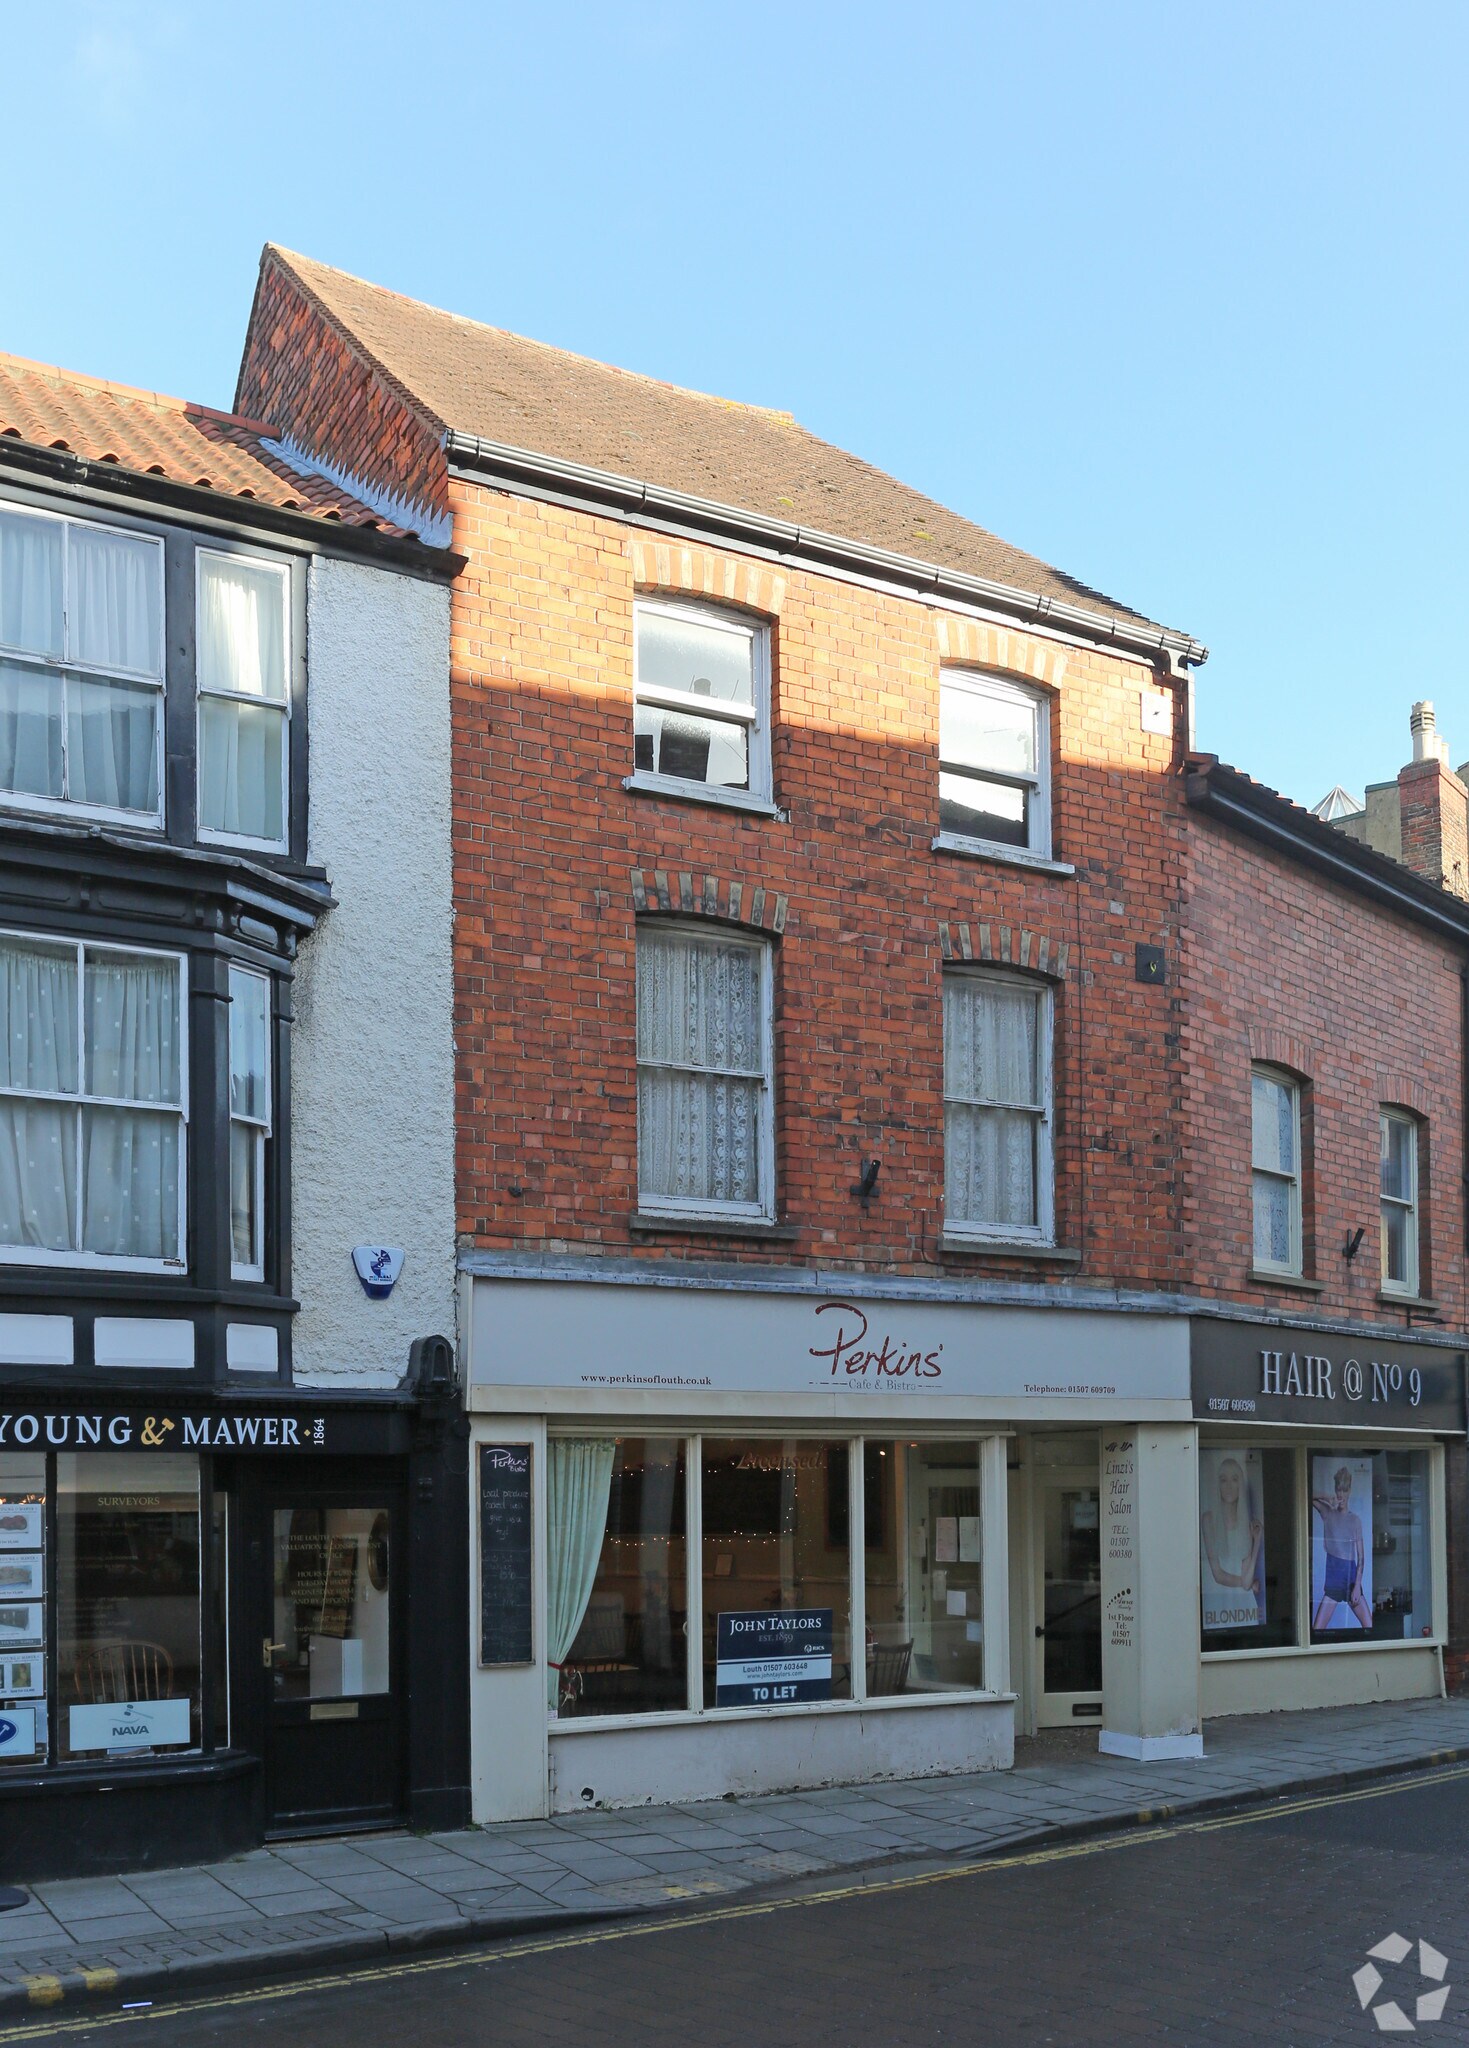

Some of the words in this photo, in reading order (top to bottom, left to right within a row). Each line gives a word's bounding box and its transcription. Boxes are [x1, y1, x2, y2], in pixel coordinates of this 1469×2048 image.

[809, 1302, 944, 1377] Perkins'
[581, 1374, 712, 1385] www.perkinsoflouth.co.uk
[1260, 1350, 1335, 1399] HAIR
[1343, 1359, 1363, 1401] @
[1409, 1368, 1422, 1406] 9
[848, 1378, 872, 1390] Cafe
[874, 1379, 883, 1390] &
[886, 1380, 916, 1391] Bistro
[1024, 1384, 1067, 1394] Telephone:
[1068, 1385, 1089, 1393] 01507
[1090, 1386, 1115, 1394] 609709
[1208, 1398, 1231, 1411] 01507
[0, 1414, 132, 1444] YOUNG
[141, 1416, 171, 1445] &
[182, 1416, 301, 1445] MAWER
[314, 1418, 325, 1445] 1864
[1105, 1460, 1134, 1475] Linzi's
[1109, 1479, 1130, 1495] Hair
[98, 1497, 161, 1506] SURVEYORS
[1108, 1498, 1132, 1516] Salon
[1111, 1525, 1128, 1535] TEL:
[1110, 1538, 1130, 1547] 01507
[1108, 1550, 1132, 1559] 600380
[1118, 1613, 1134, 1621] Floor
[1205, 1607, 1264, 1625] BLONDME
[730, 1619, 766, 1636] JOHN
[768, 1617, 822, 1630] TAYLORS
[758, 1634, 774, 1642] EST.
[775, 1631, 794, 1643] 1859
[1112, 1630, 1130, 1638] 01507
[743, 1664, 762, 1673] Louth
[763, 1663, 782, 1671] 01507
[784, 1662, 808, 1670] 603648
[747, 1670, 803, 1679] www.johntaylors.com
[753, 1687, 769, 1700] TO
[773, 1685, 797, 1699] LET
[112, 1725, 150, 1736] NAVA
